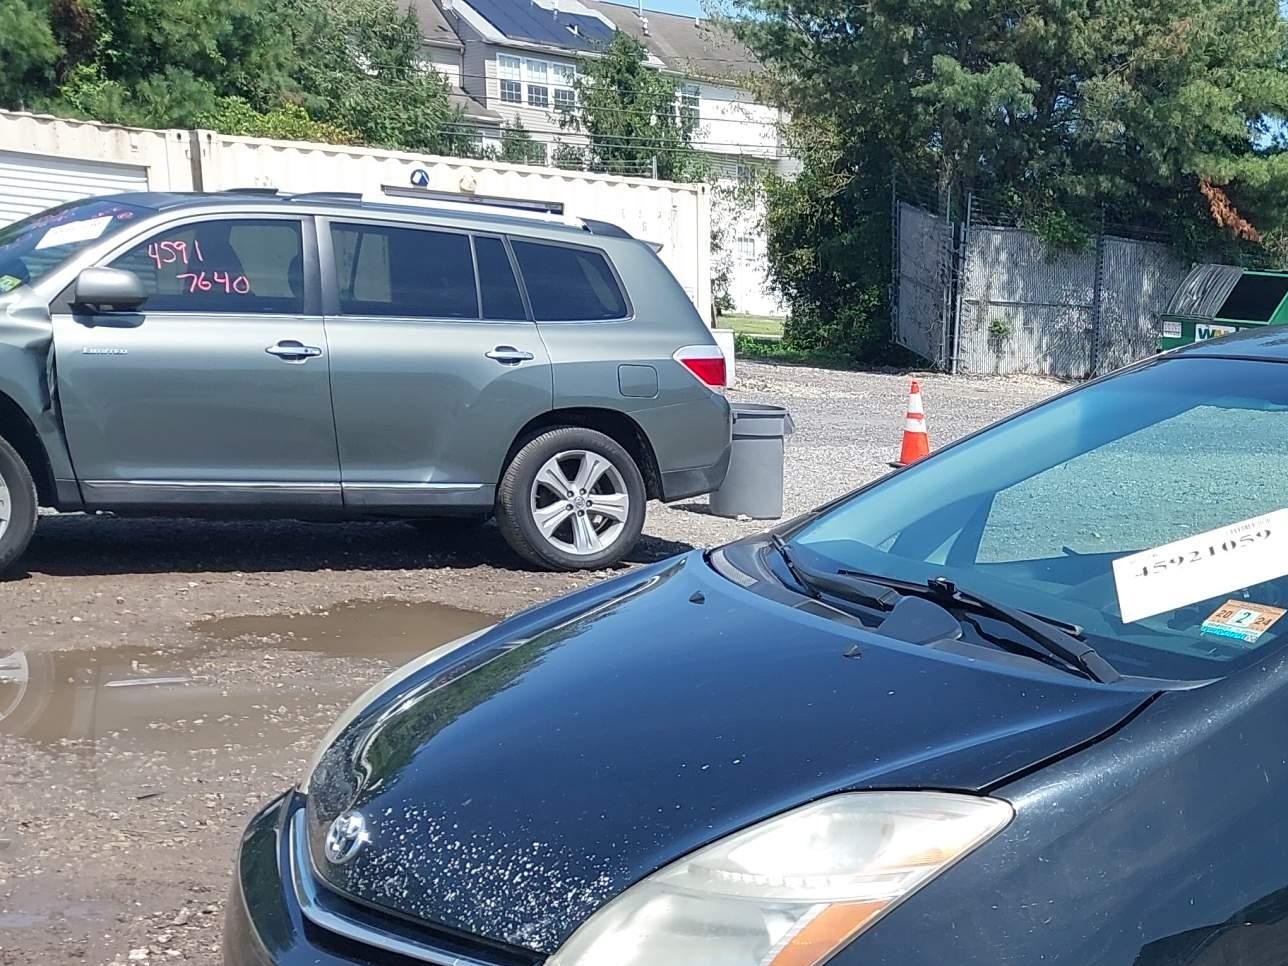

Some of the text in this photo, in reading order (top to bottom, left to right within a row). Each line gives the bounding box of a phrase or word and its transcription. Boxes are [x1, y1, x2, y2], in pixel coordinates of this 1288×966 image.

[148, 239, 203, 269] 4591
[176, 271, 250, 294] 7640
[1215, 609, 1233, 619] 20
